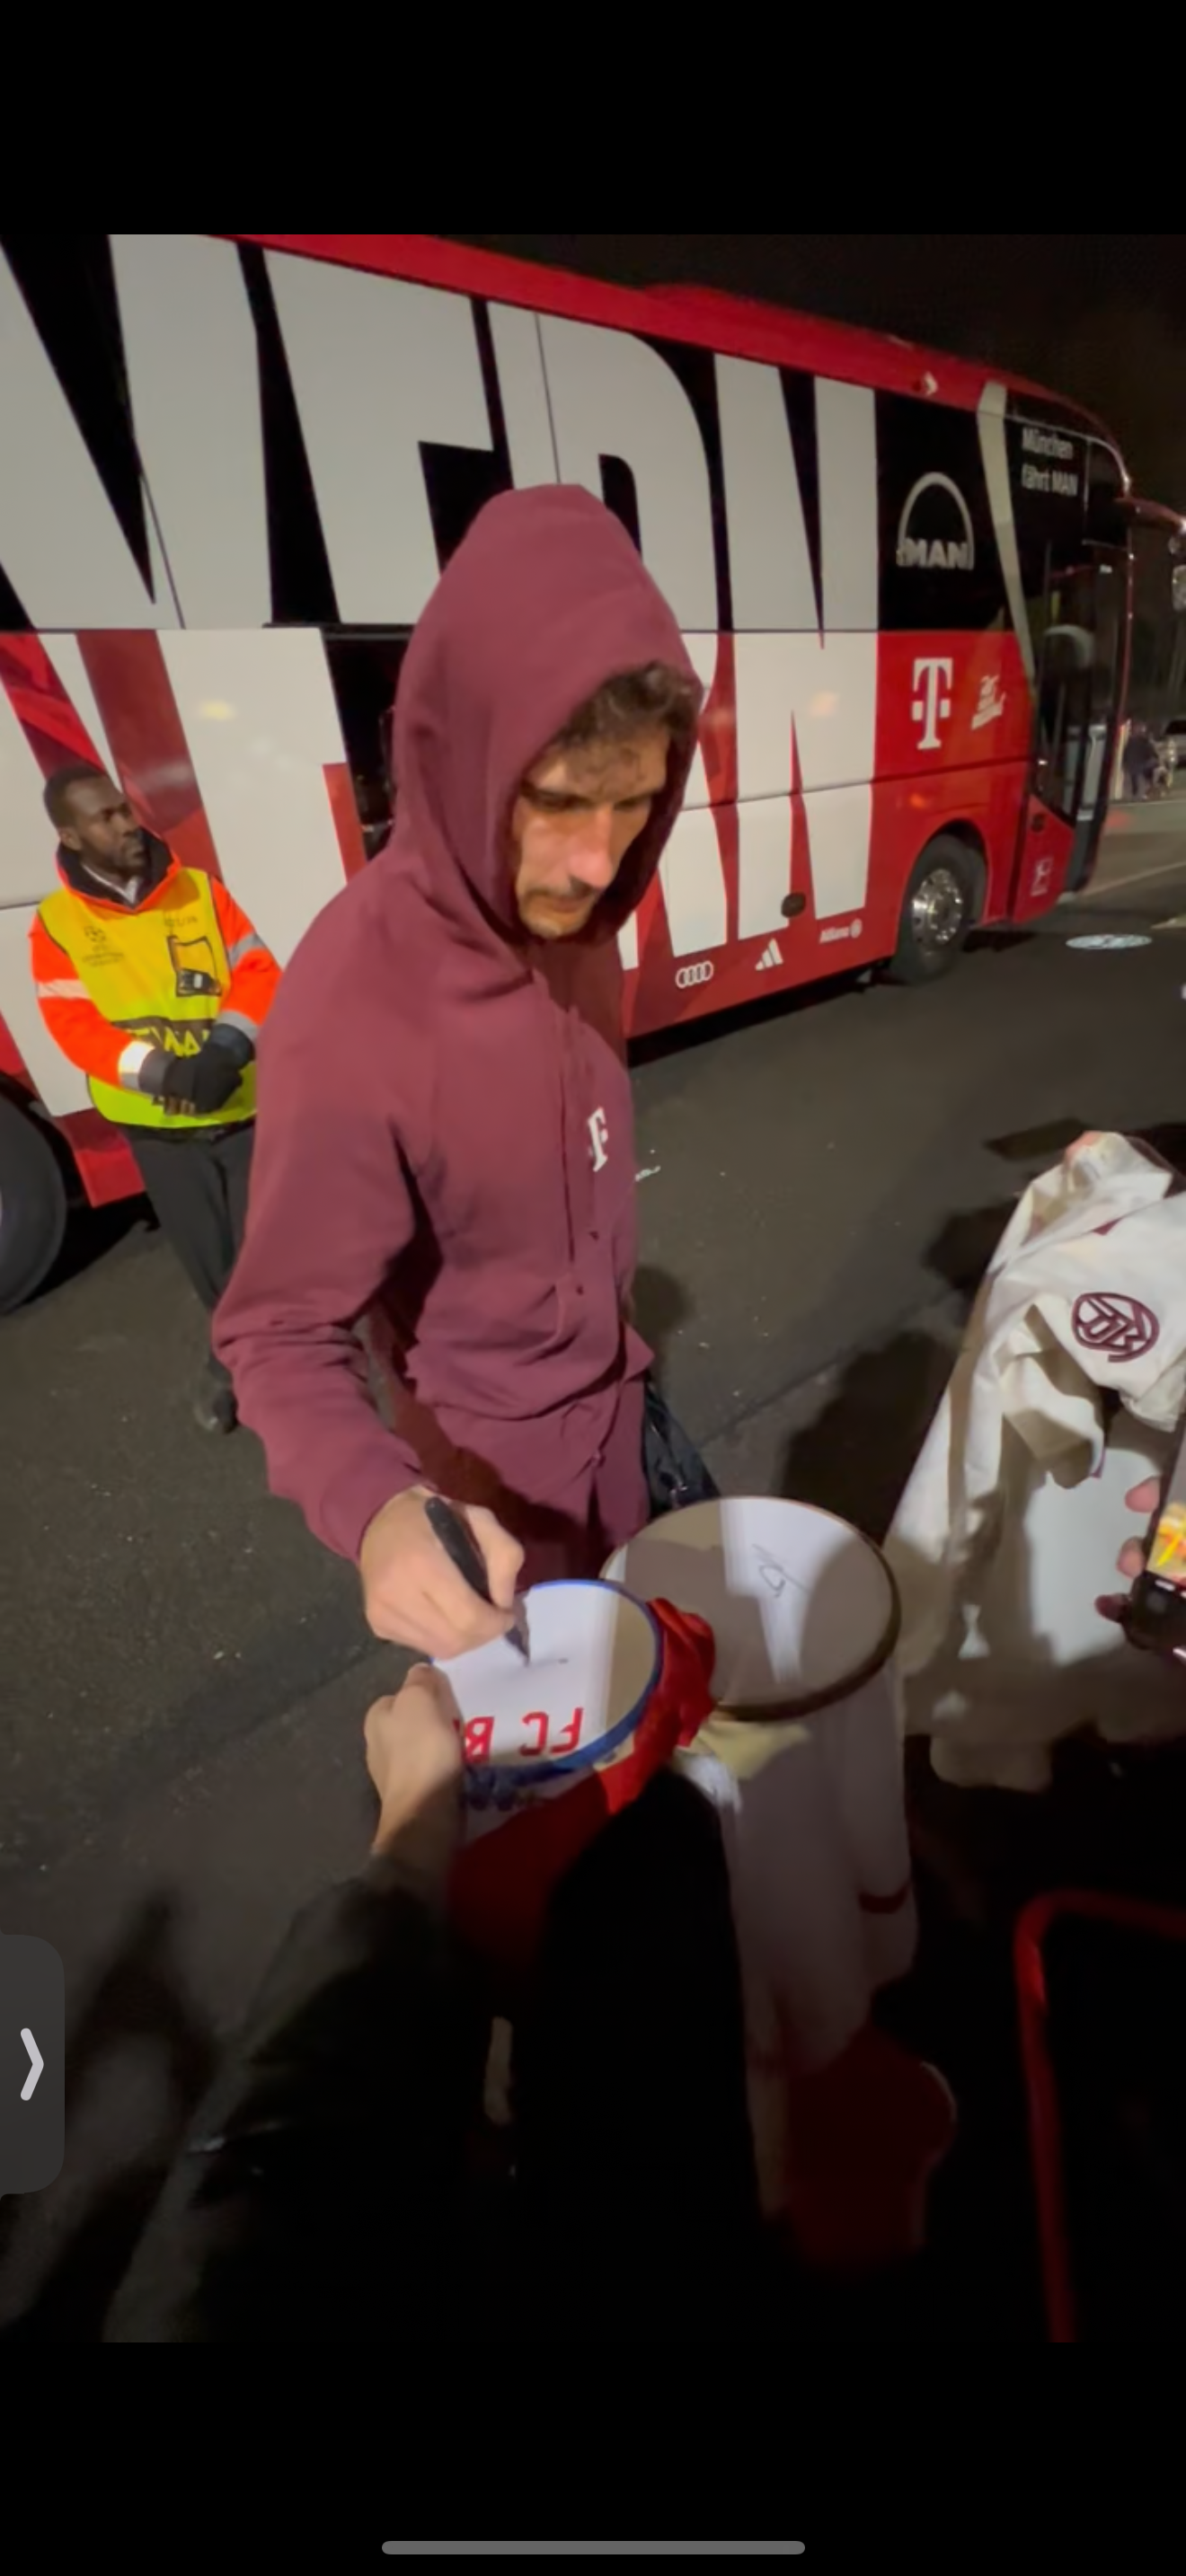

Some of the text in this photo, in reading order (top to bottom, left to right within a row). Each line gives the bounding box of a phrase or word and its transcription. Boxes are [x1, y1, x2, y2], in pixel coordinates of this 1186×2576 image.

[1052, 469, 1078, 497] MAN
[898, 537, 970, 570] MAN
[911, 657, 953, 751] T
